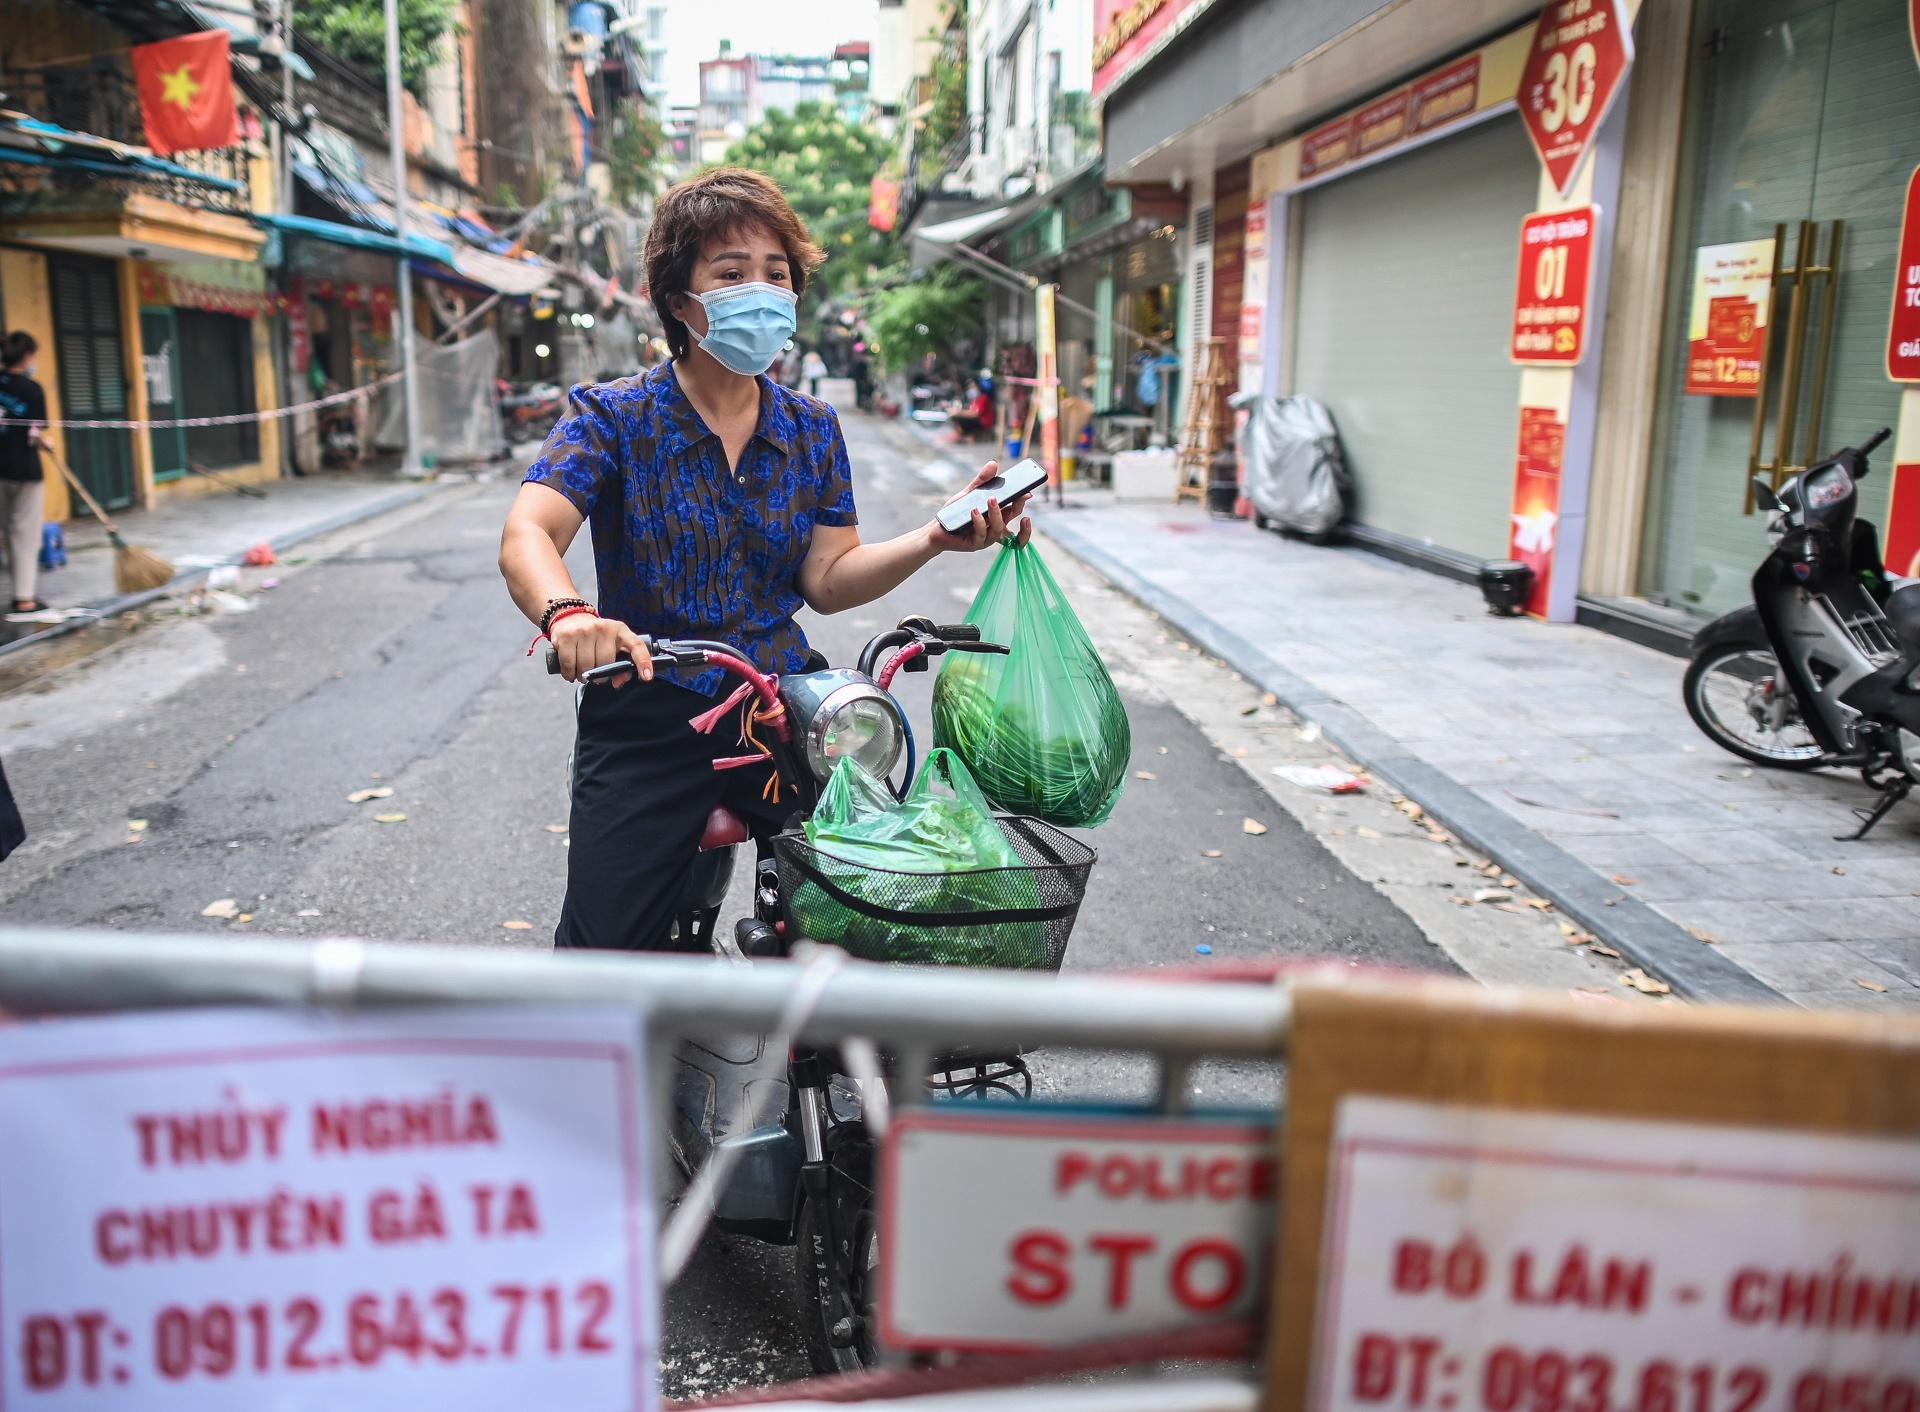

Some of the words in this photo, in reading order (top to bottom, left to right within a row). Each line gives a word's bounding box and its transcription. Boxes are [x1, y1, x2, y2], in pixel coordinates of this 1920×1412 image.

[1541, 41, 1597, 133] 30
[1535, 245, 1569, 300] 01
[1908, 265, 1920, 285] U
[1715, 356, 1737, 383] 12
[95, 1182, 345, 1265] CHUYÊN
[367, 1173, 446, 1245] GÀ
[467, 1181, 539, 1236] TA
[1007, 1228, 1268, 1312] STO
[22, 1311, 131, 1392] ĐT:
[154, 1281, 614, 1380] 0912.643.712
[1350, 1331, 1461, 1410] ĐT:
